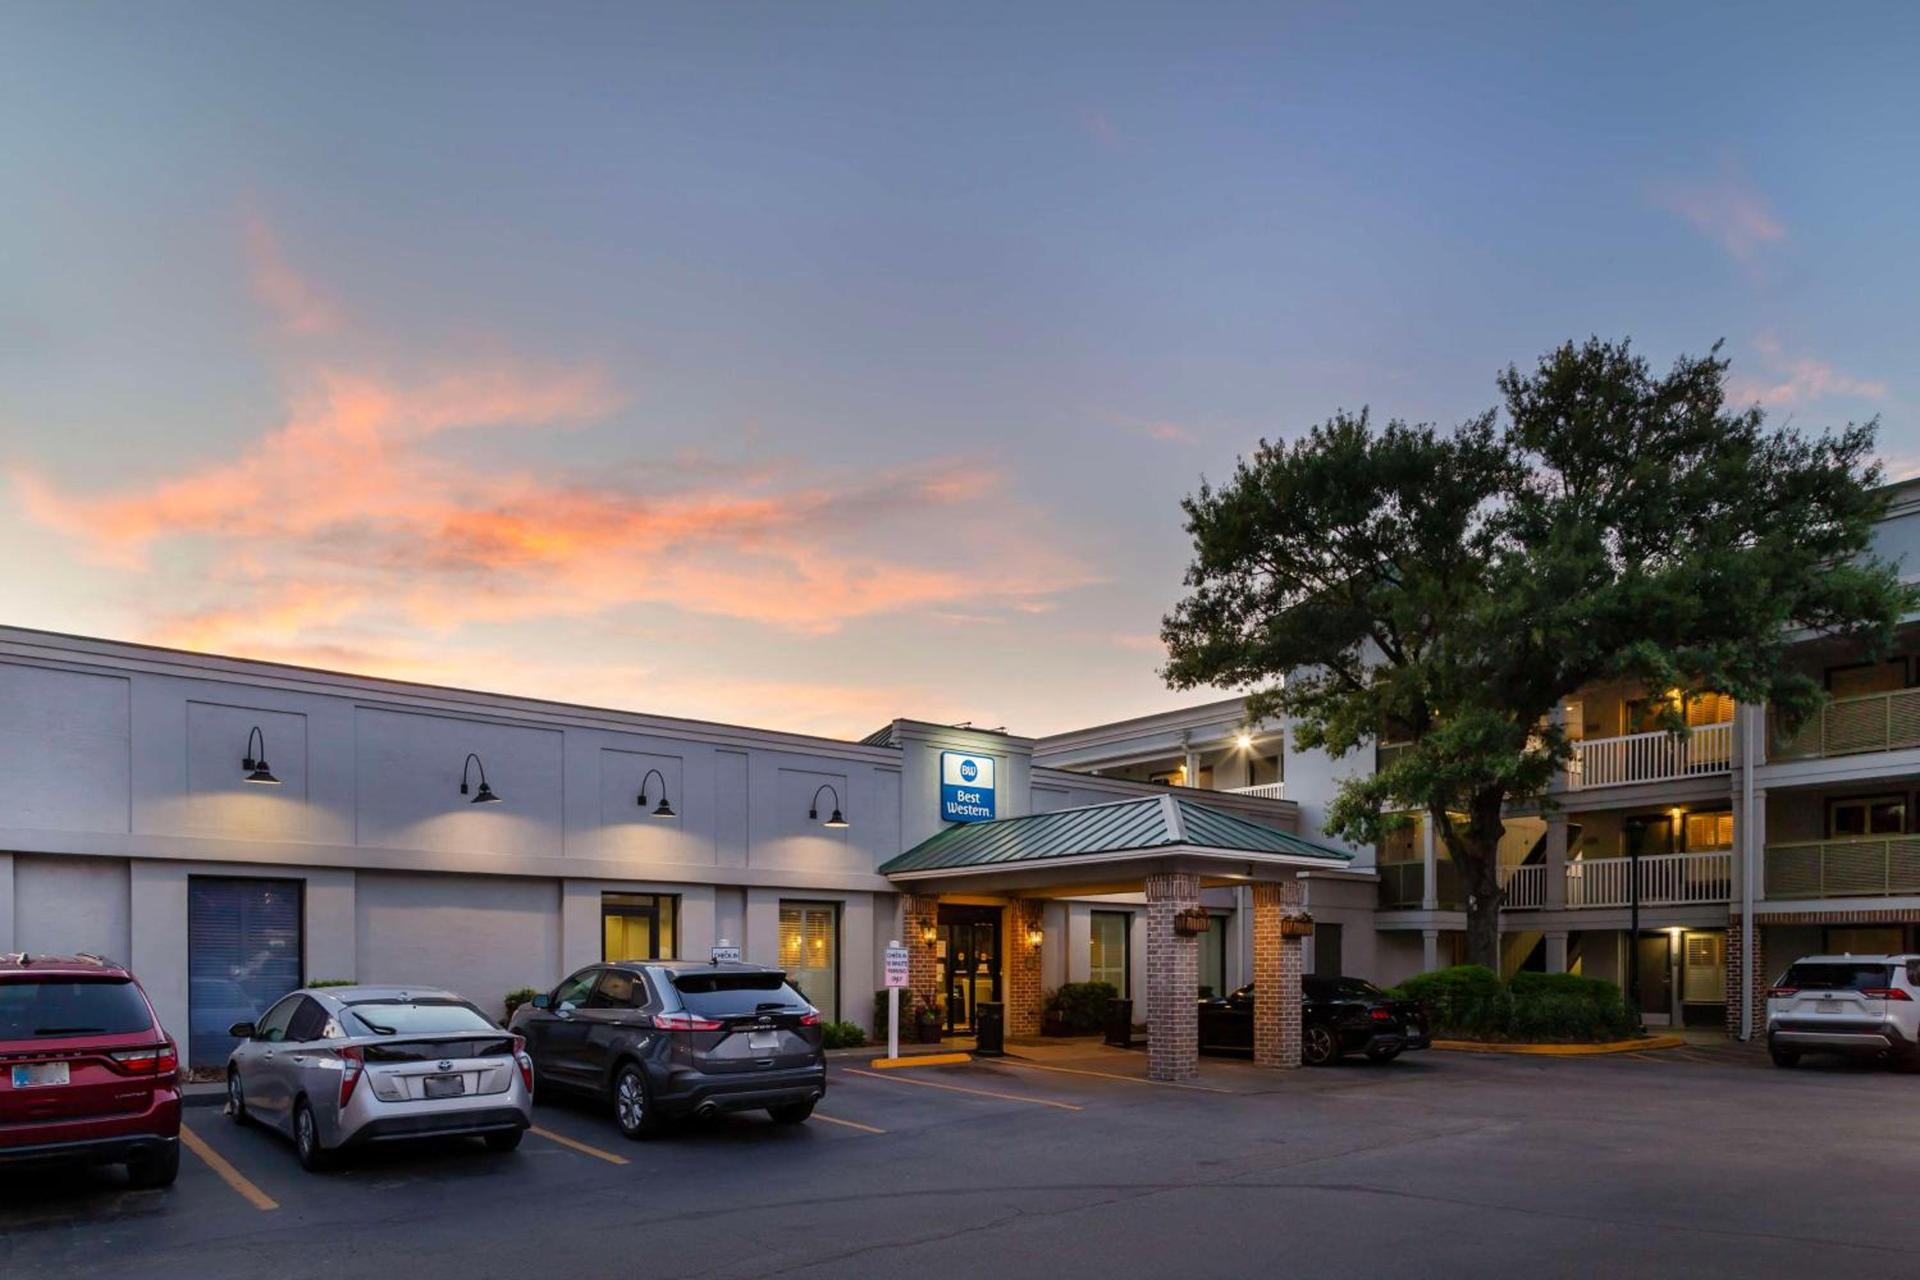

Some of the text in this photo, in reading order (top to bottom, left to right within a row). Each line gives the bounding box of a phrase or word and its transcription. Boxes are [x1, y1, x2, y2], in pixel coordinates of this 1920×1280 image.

[962, 765, 976, 777] BW
[957, 790, 981, 804] Best
[946, 801, 990, 817] Western
